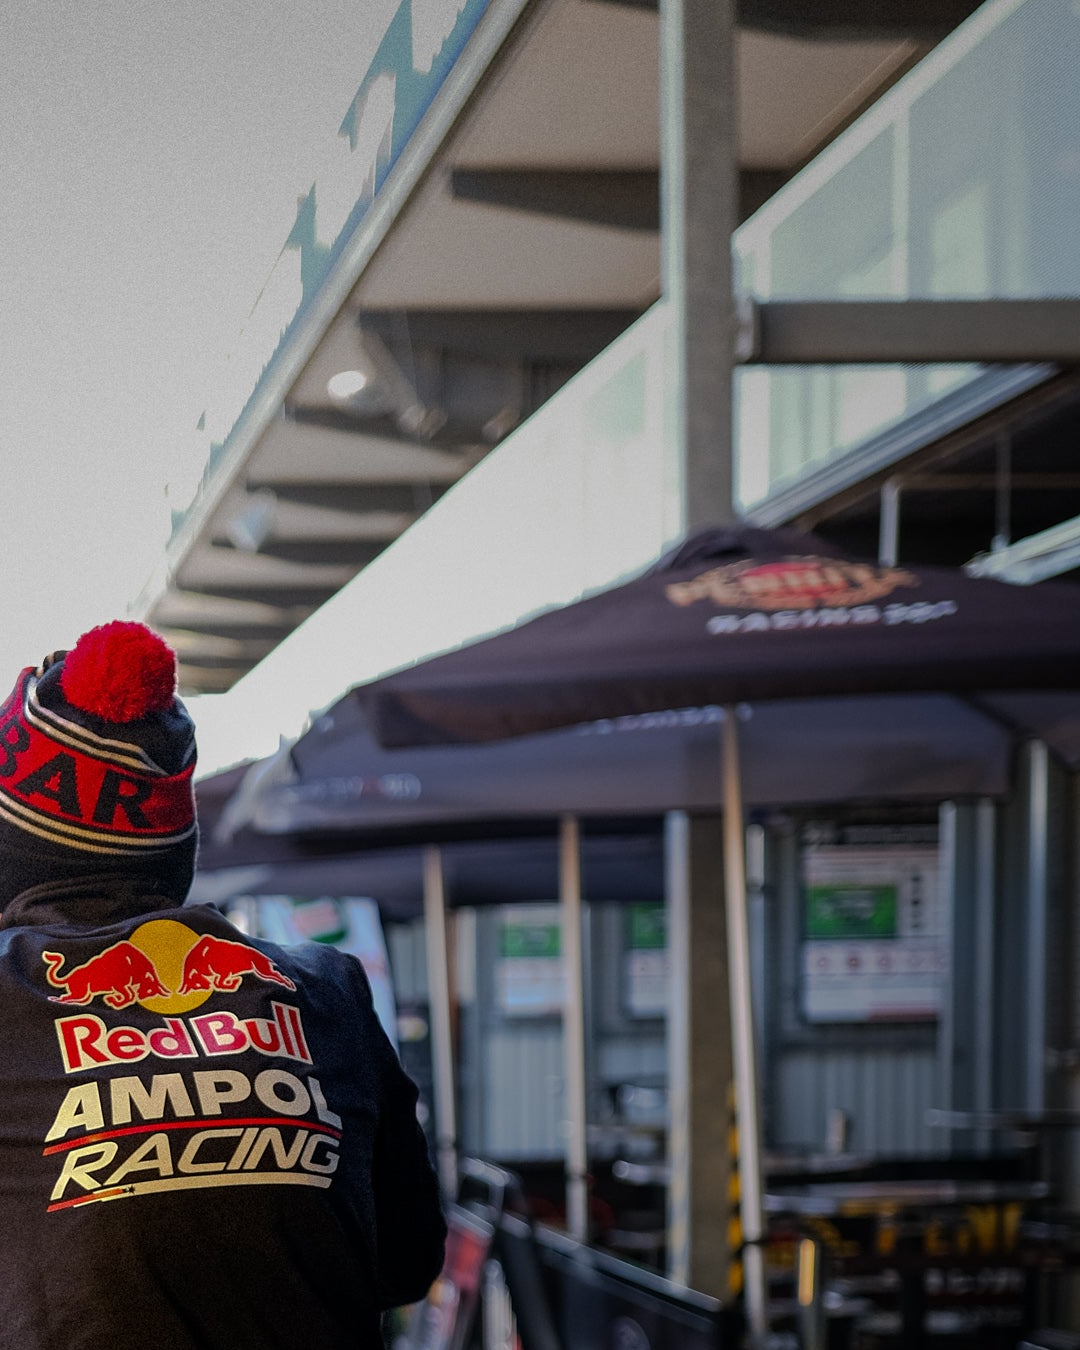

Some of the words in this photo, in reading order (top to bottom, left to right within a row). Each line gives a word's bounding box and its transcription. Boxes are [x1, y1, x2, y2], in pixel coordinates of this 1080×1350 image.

[56, 1014, 198, 1073] Red
[190, 1001, 313, 1064] Bull
[44, 1069, 343, 1143] AMPOL
[50, 1127, 343, 1200] RACING
